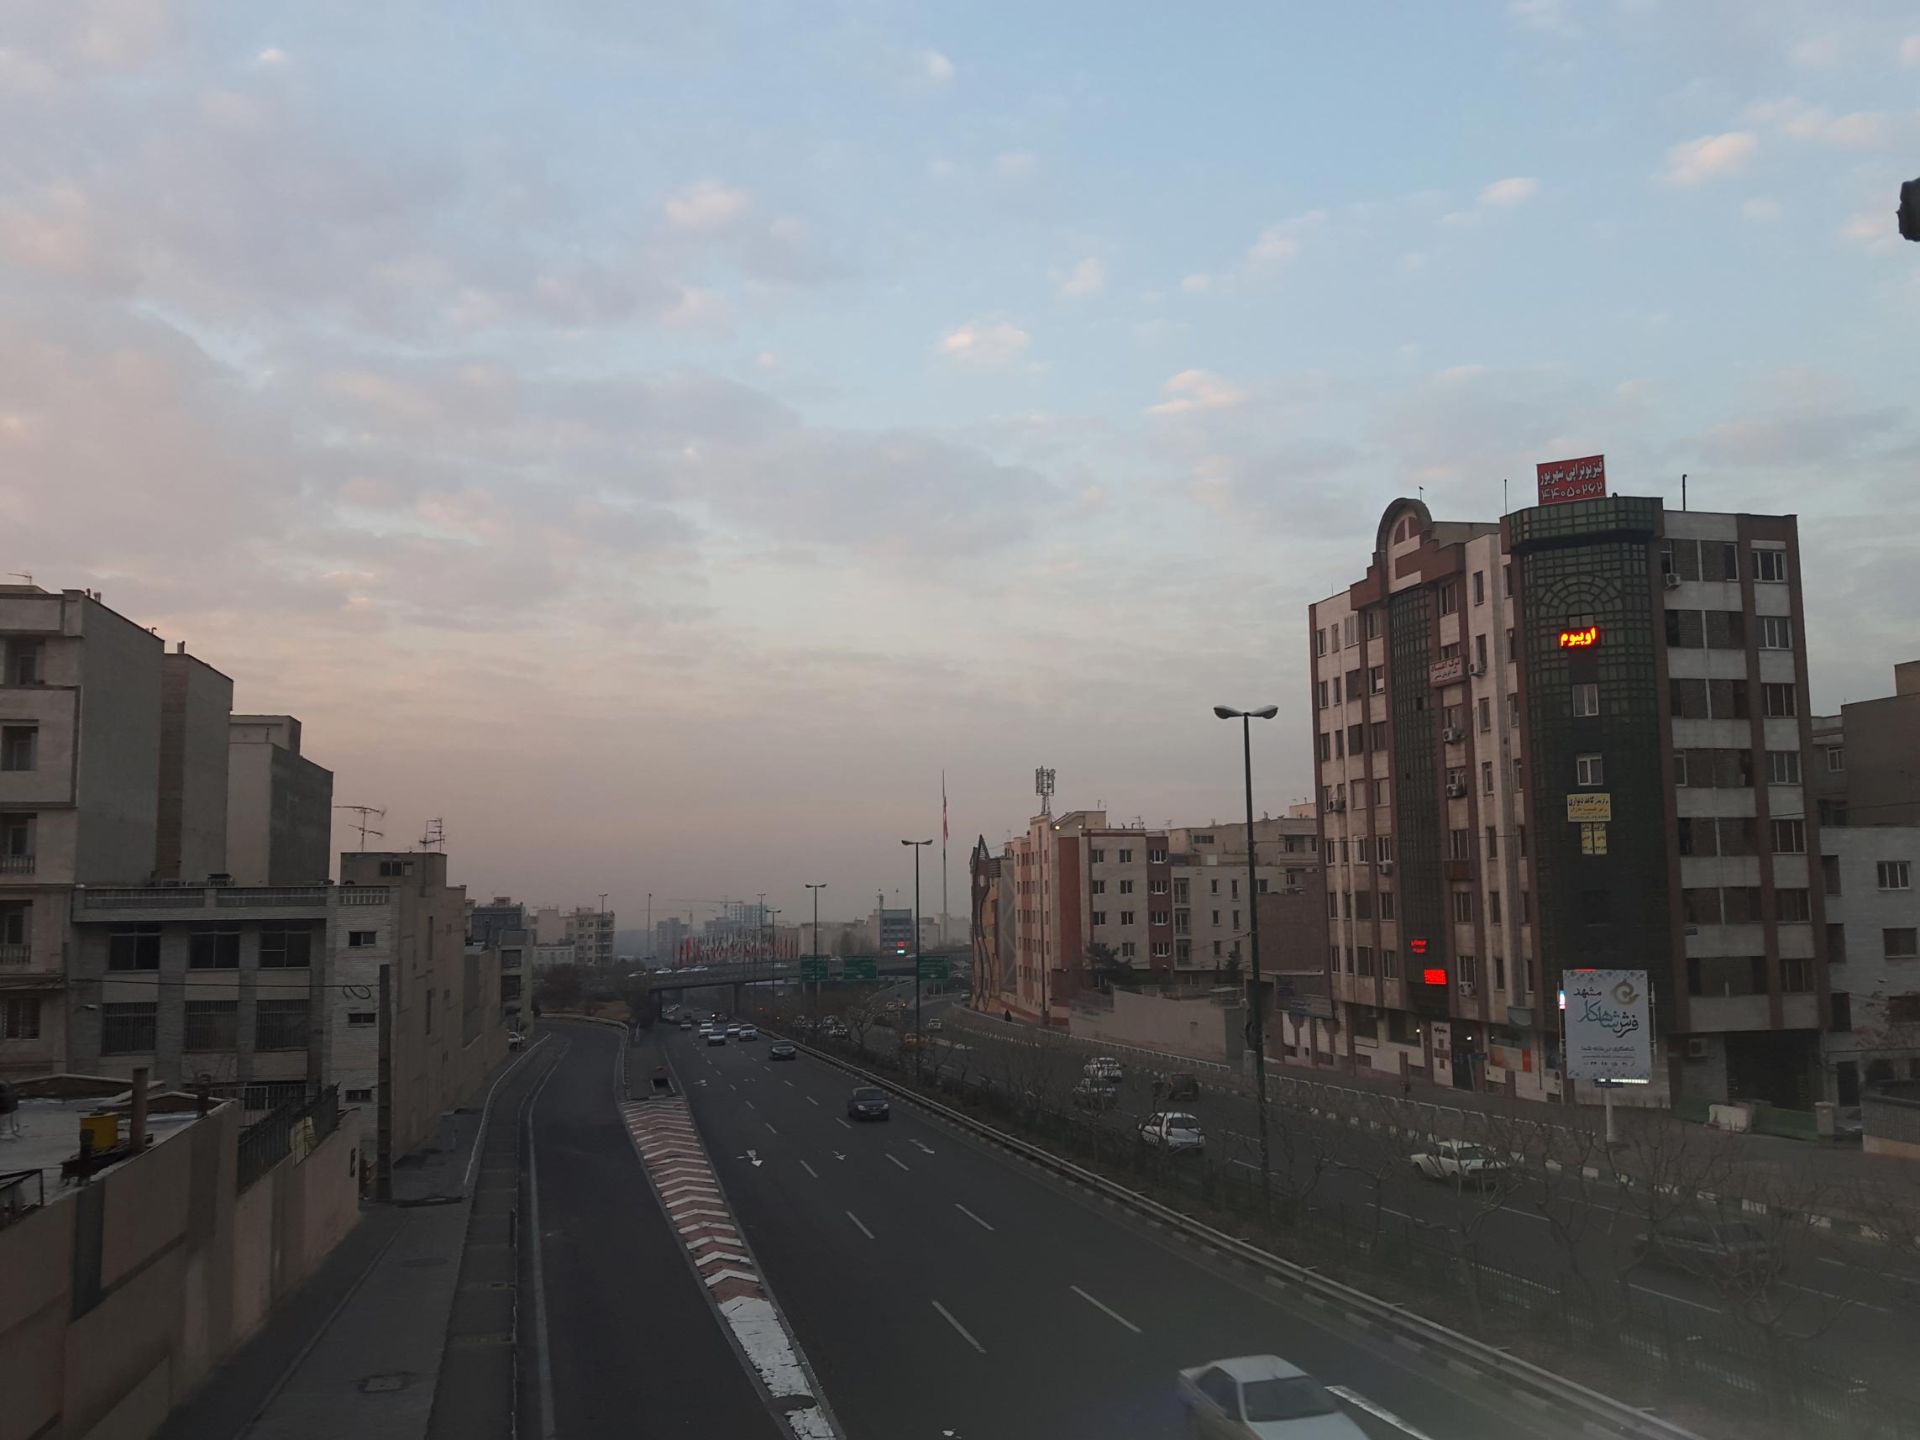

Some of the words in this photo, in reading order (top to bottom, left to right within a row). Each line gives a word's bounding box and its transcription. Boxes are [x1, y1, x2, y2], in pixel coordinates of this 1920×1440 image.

[1565, 460, 1603, 482] فیزیوتراپی
[1559, 626, 1597, 647] اوپیوم
[1573, 986, 1602, 998] مشهد
[1576, 999, 1619, 1028] شاهکار
[1612, 1011, 1639, 1038] فرش
